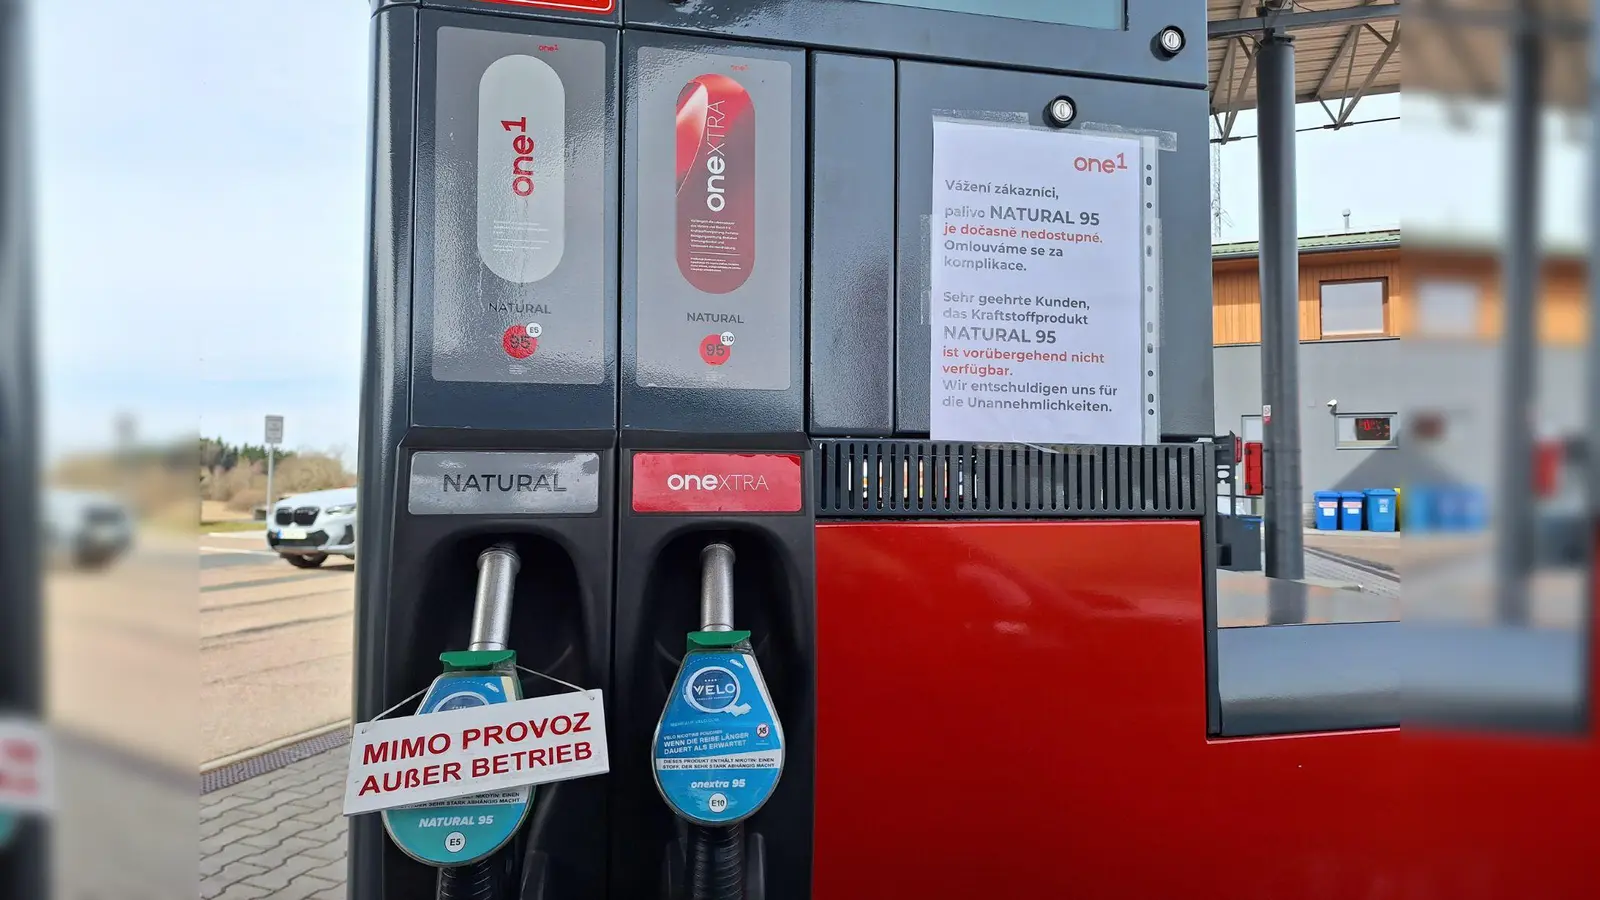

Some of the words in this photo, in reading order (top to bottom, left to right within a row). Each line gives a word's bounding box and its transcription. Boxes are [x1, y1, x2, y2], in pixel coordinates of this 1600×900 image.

[500, 116, 534, 197] one1
[1074, 152, 1127, 173] one1
[945, 179, 991, 194] Vážení
[994, 183, 1059, 200] zákazníci,
[944, 205, 985, 219] palivo
[990, 206, 1075, 224] NATURAL
[1080, 212, 1100, 226] 95
[943, 223, 956, 236] je
[960, 224, 1016, 238] dočasně
[1021, 228, 1103, 244] nedostupné.
[944, 240, 1027, 255] Omlouváme
[1031, 246, 1045, 256] se
[1049, 247, 1063, 257] za
[944, 256, 1027, 272] komplikace.
[488, 303, 552, 314] NATURAL
[943, 292, 975, 303] Sehr
[979, 293, 1031, 306] geehrte
[1035, 296, 1090, 310] Kunden,
[687, 312, 744, 324] NATURAL
[943, 308, 967, 319] das
[972, 309, 1088, 325] Kraftstoffprodukt
[510, 334, 530, 348] 95
[944, 326, 1031, 343] NATURAL
[1036, 330, 1056, 344] 95
[706, 344, 724, 356] 95
[943, 346, 959, 357] ist
[963, 347, 1067, 363] vorübergehend
[1072, 352, 1105, 363] nicht
[943, 363, 1013, 377] verfügbar.
[943, 380, 967, 391] Wir
[971, 380, 1067, 396] entschuldigen
[1072, 385, 1096, 396] uns
[1099, 385, 1117, 396] für
[942, 396, 963, 408] die
[968, 397, 1112, 412] Unannehmlichkeiten.
[443, 474, 567, 492] NATURAL
[667, 474, 769, 491] oneXTRA
[693, 683, 736, 695] VELO
[363, 733, 451, 765] MIMO
[462, 712, 591, 750] PROVOZ
[700, 735, 720, 743] REISE
[721, 732, 749, 741] LÄNGER
[664, 747, 692, 755] DAUERT
[709, 740, 746, 749] ERWARTET
[358, 761, 462, 796] AUßER
[472, 742, 592, 778] BETRIEB
[691, 780, 729, 788] onextra
[732, 779, 746, 788] 95
[418, 816, 475, 828] NATURAL
[478, 815, 494, 825] 95
[450, 838, 461, 846] E5
